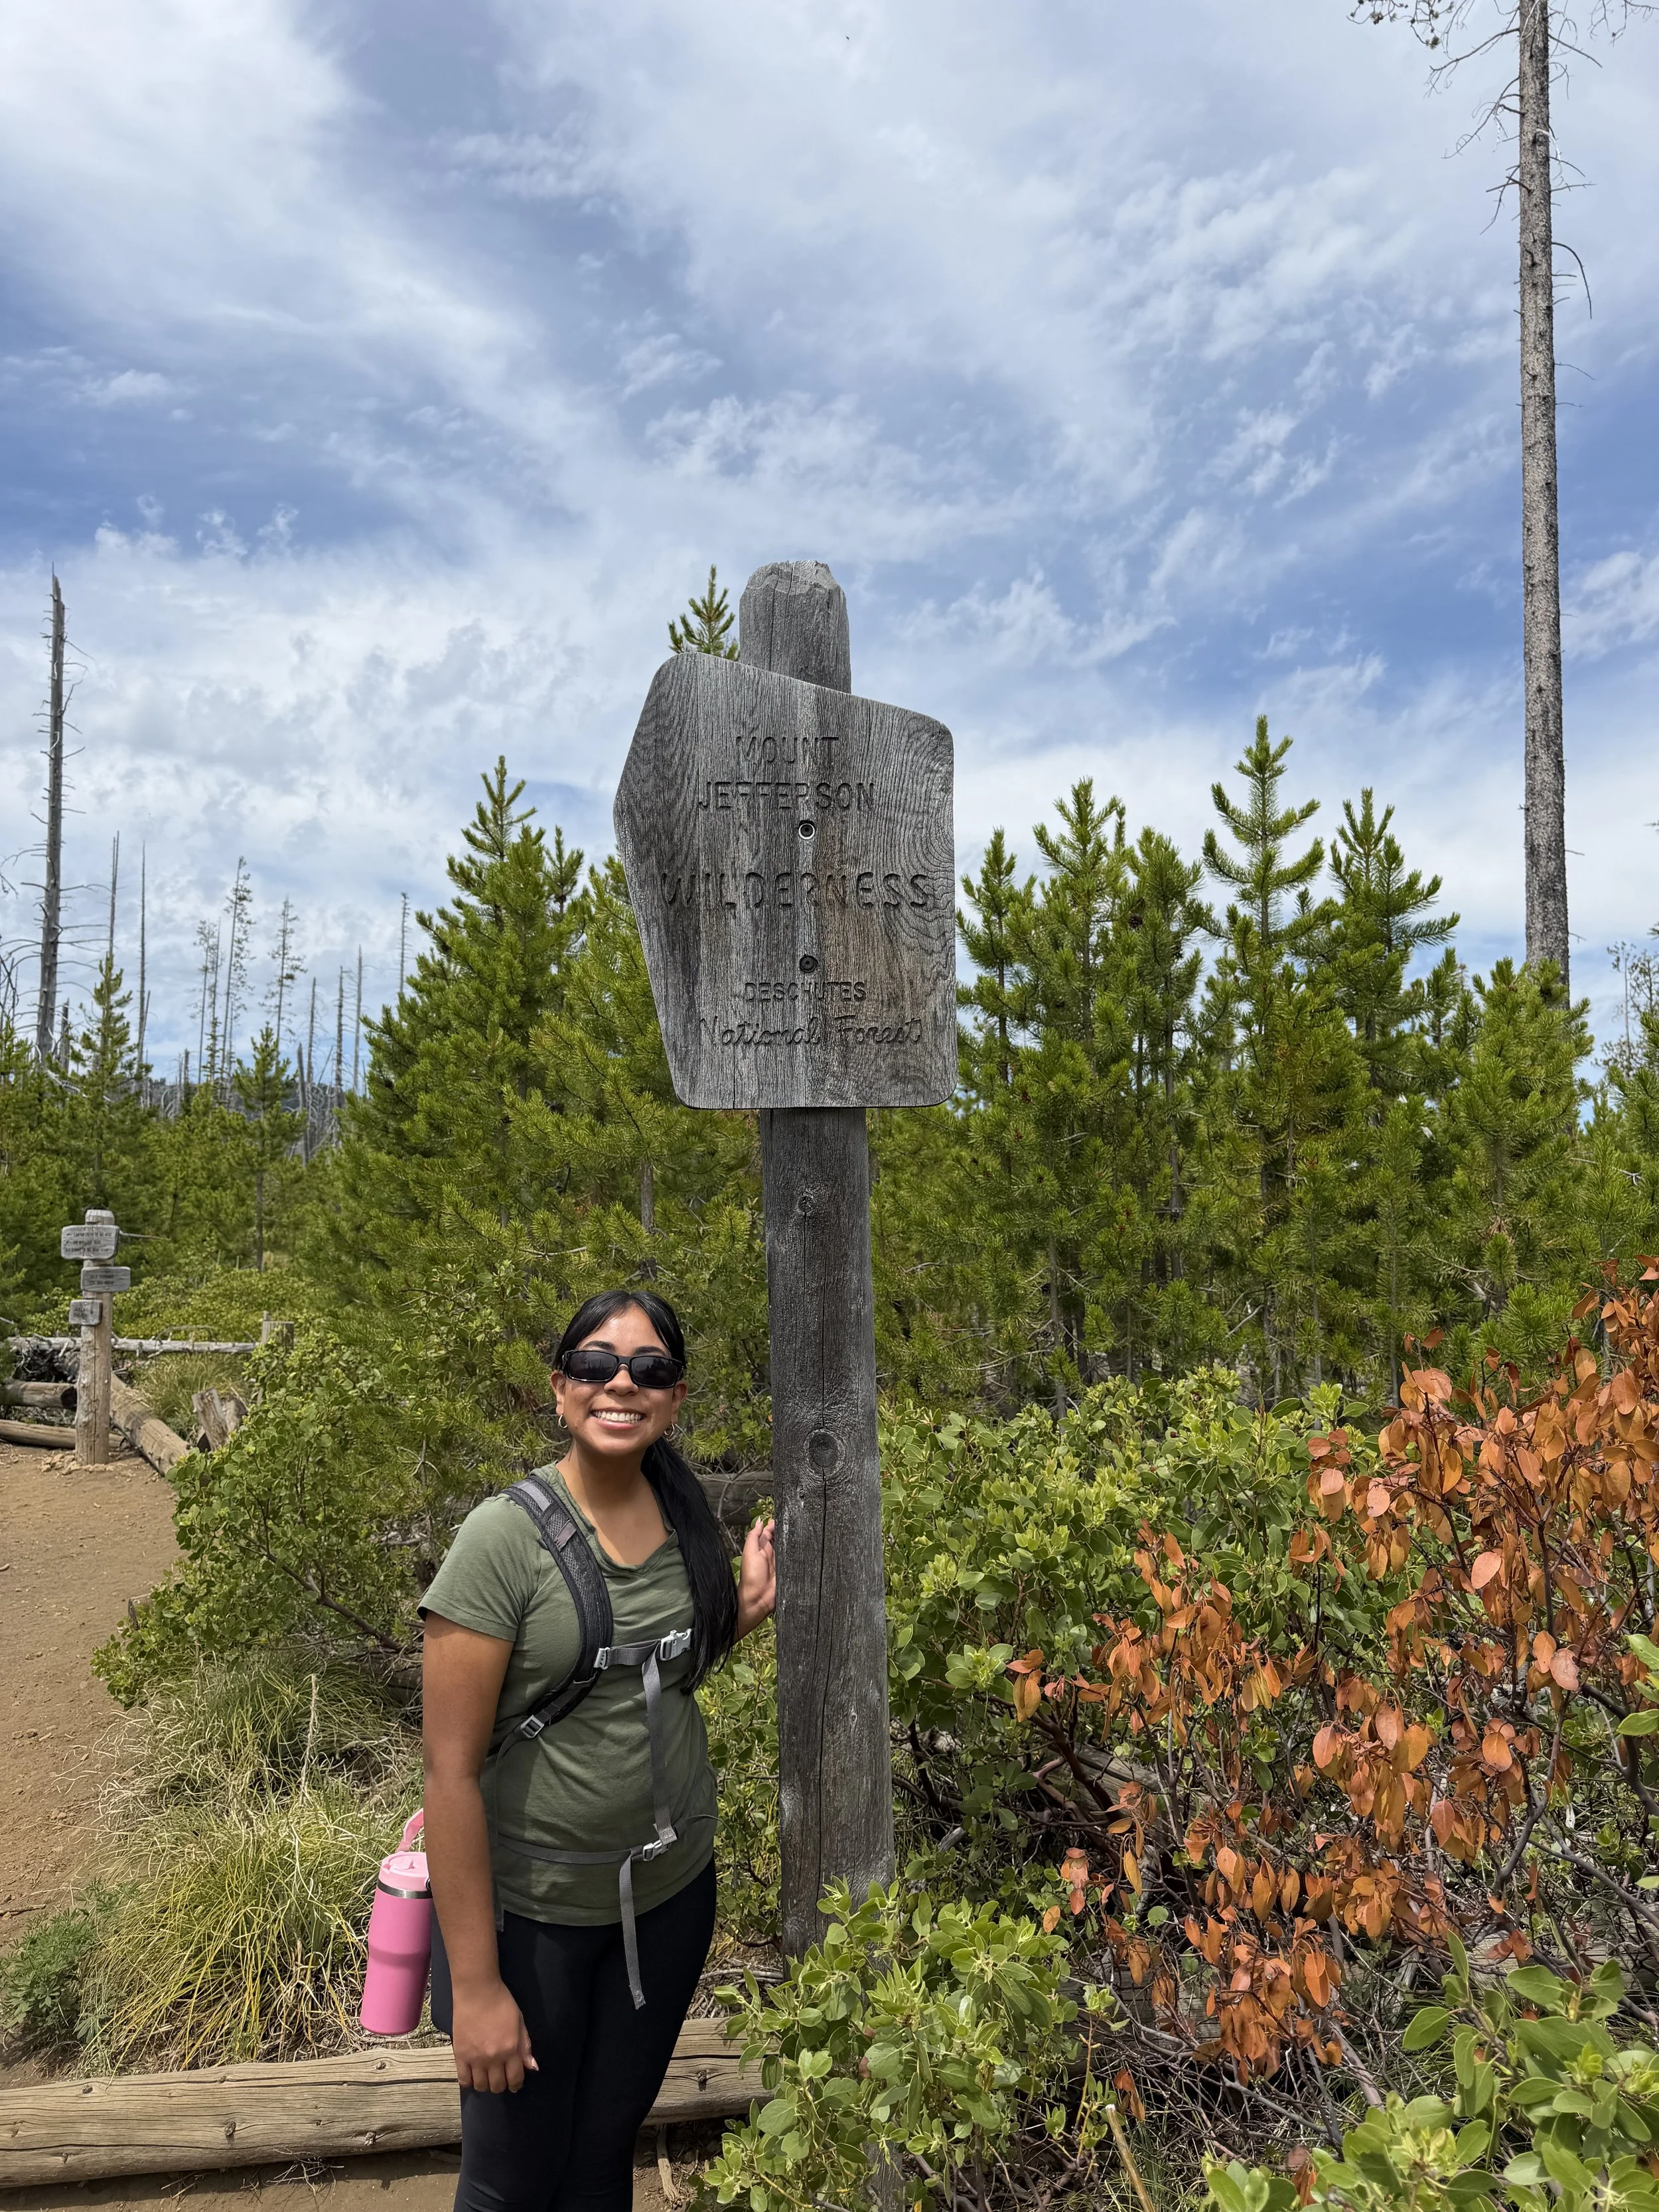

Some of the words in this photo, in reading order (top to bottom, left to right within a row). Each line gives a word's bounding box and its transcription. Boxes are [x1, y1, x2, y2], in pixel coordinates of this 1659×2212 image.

[735, 735, 839, 764] MOUNT
[698, 780, 875, 811] JEFFERSON
[661, 871, 929, 908] WILDERNESS
[745, 981, 867, 1001] DESCHUTES
[699, 1015, 821, 1045] National
[834, 1015, 922, 1045] Forest
